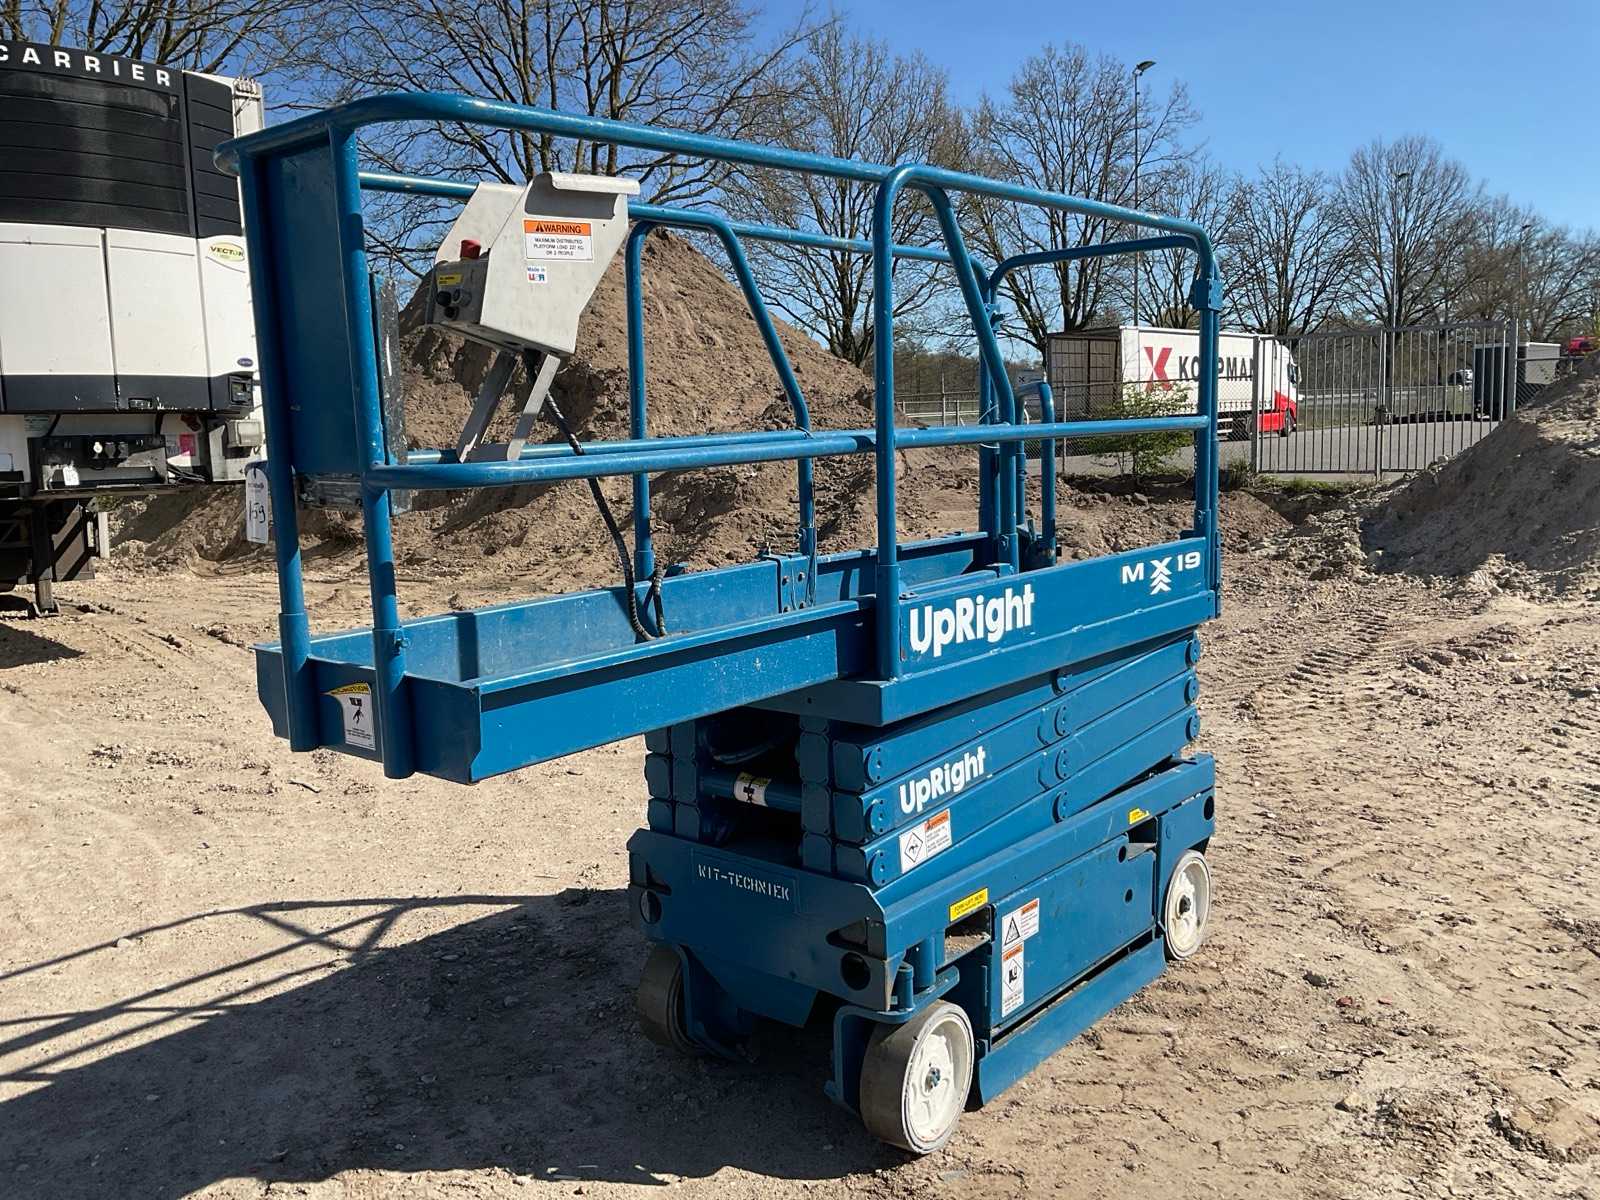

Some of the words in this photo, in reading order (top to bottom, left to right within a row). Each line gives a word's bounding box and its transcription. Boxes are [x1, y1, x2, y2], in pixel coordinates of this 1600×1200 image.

[0, 44, 171, 87] CARRIER
[544, 224, 582, 234] WARNING
[909, 583, 1036, 657] UpRight
[899, 745, 986, 814] UpRight
